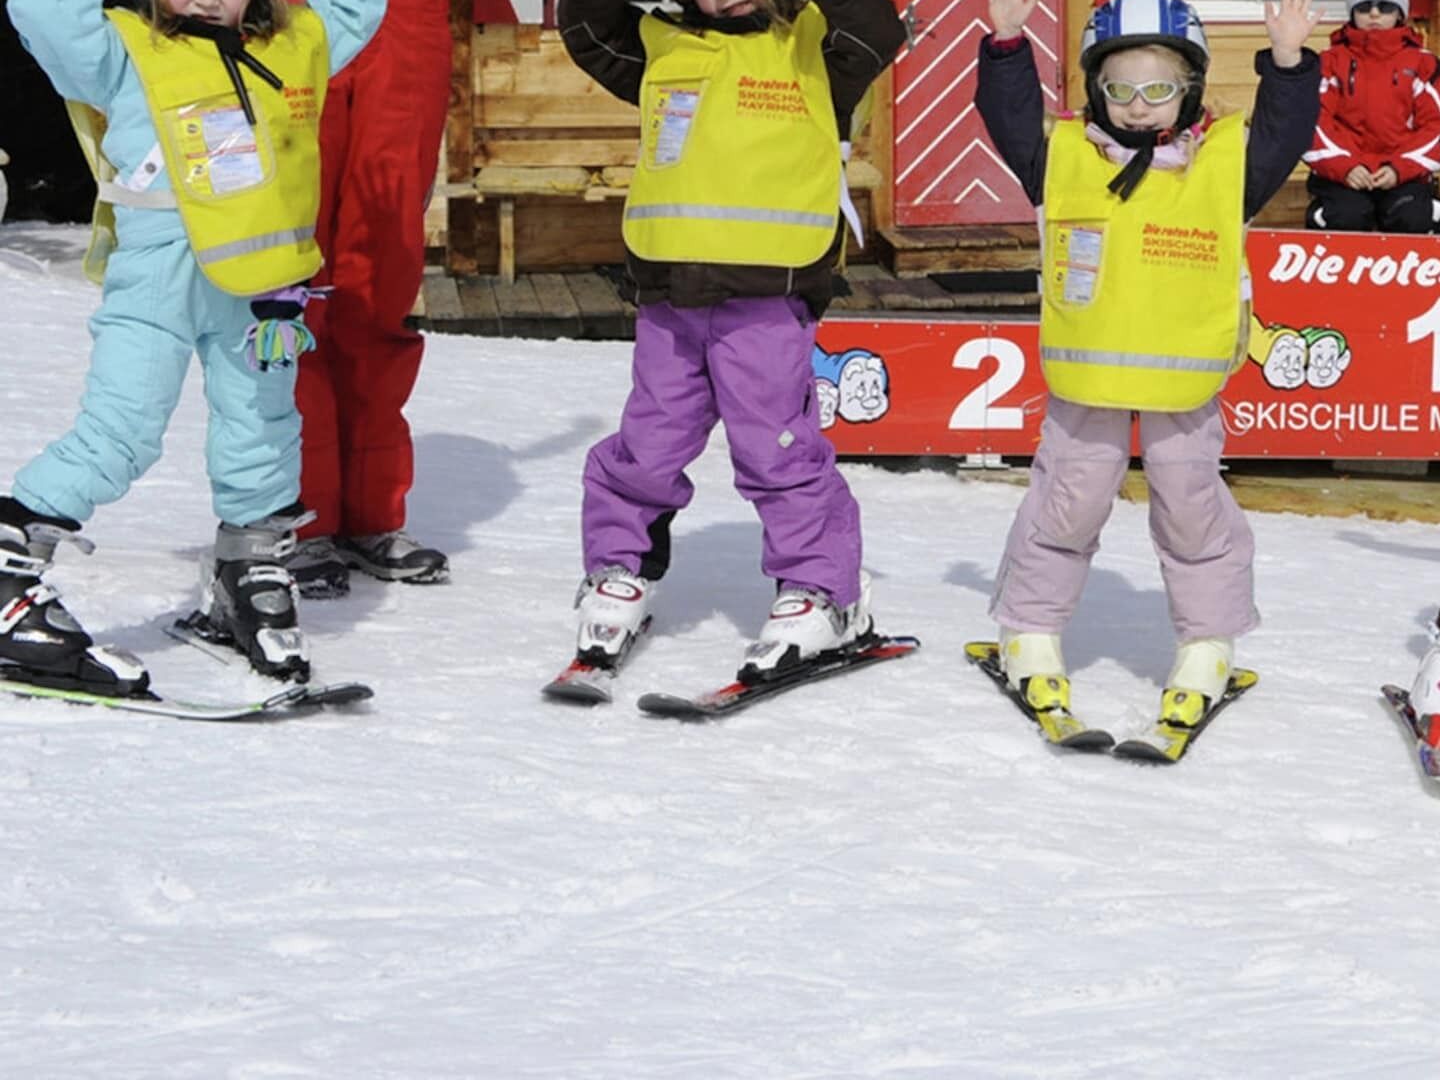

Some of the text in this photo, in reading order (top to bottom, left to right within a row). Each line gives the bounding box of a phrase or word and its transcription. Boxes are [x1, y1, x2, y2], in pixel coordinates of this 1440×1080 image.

[1142, 247, 1219, 262] MAYRHOFEN
[1143, 238, 1217, 252] SKISCHULE
[1269, 243, 1344, 284] Die
[948, 337, 1025, 430] 2
[1233, 401, 1420, 432] SKISCHULE
